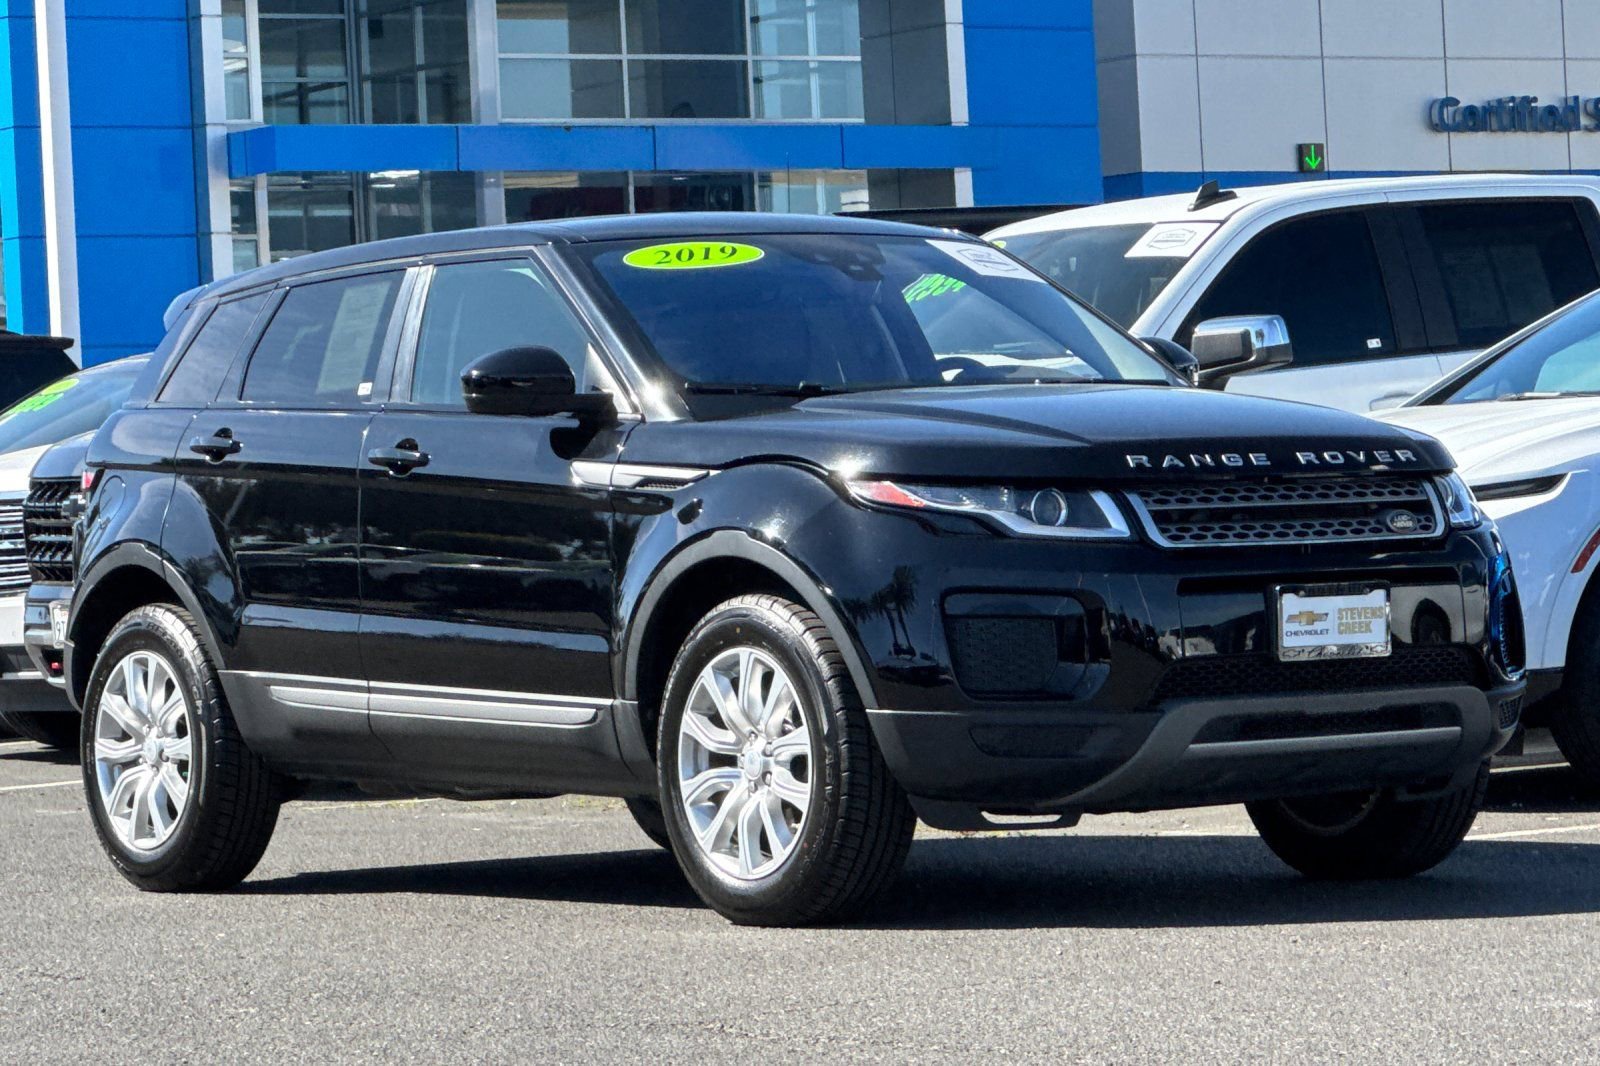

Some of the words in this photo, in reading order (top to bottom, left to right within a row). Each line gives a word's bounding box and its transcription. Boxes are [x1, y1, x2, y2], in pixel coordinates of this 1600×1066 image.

[1431, 95, 1581, 132] Certified
[654, 245, 738, 265] 2019
[1126, 453, 1271, 468] RANGE
[1296, 449, 1417, 465] ROVER
[1337, 606, 1384, 621] STEVENS
[1285, 628, 1330, 638] CHEVROLET
[1337, 620, 1373, 635] CREEK
